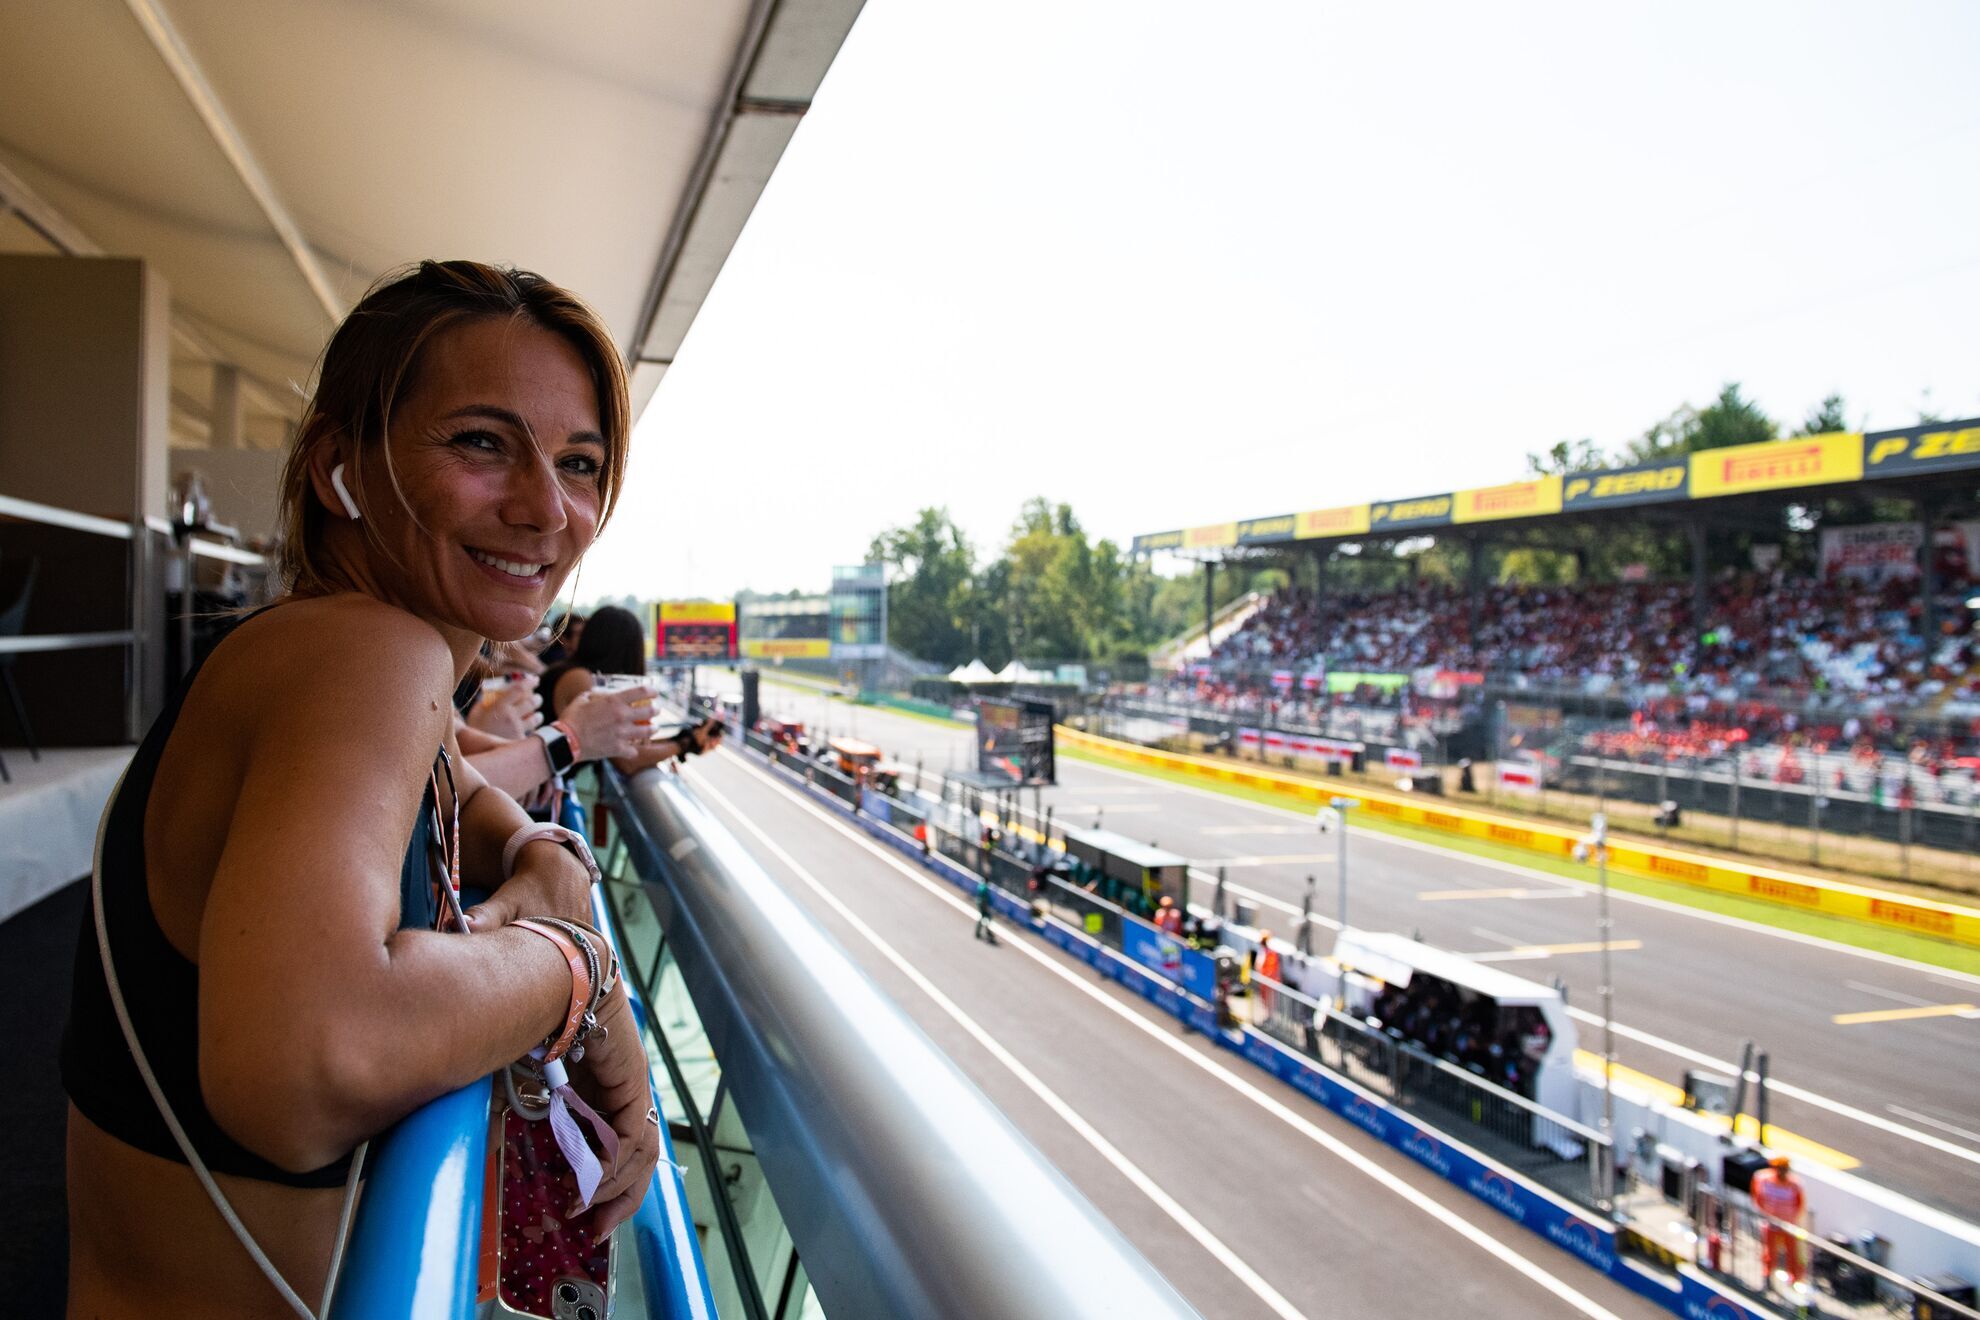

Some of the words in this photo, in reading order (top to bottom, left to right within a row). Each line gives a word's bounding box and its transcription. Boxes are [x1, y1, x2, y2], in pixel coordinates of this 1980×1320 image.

[1722, 445, 1822, 483] PIRELLI
[1868, 437, 1909, 464] P
[1565, 478, 1591, 501] P
[1591, 466, 1686, 497] ZERO
